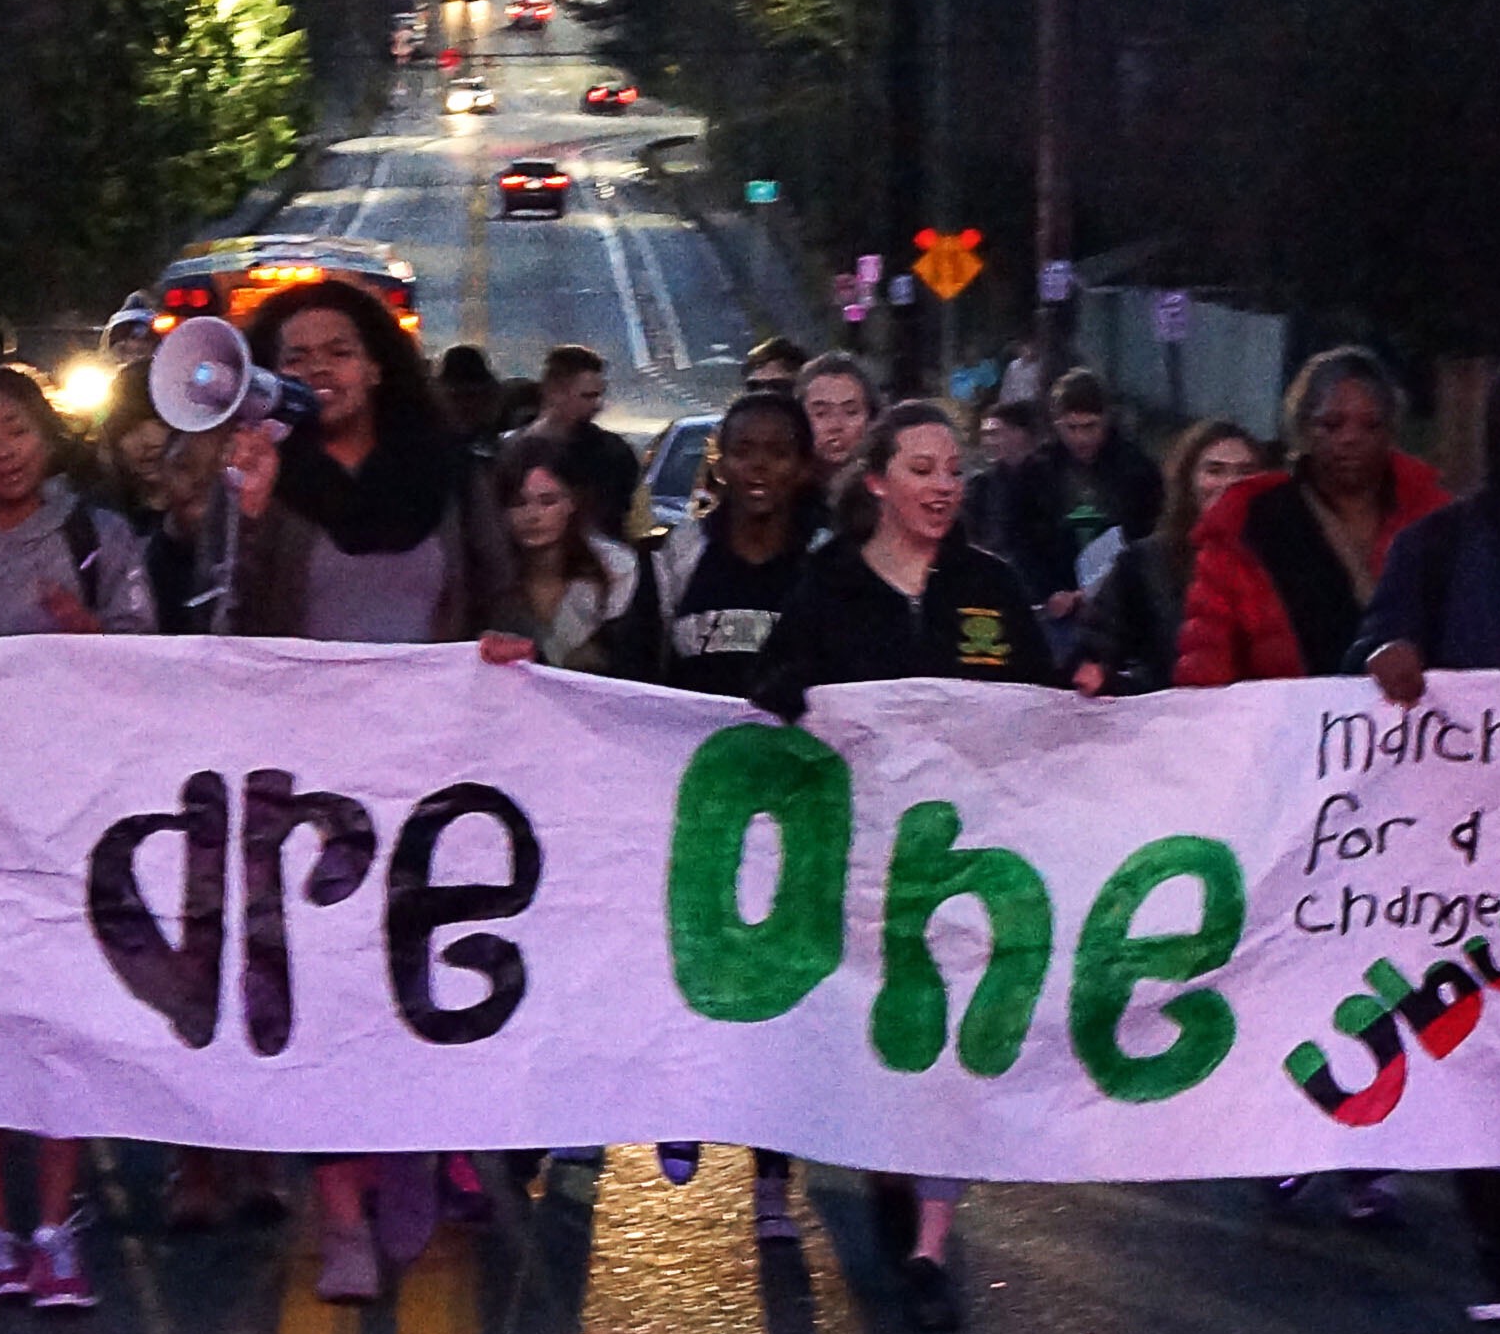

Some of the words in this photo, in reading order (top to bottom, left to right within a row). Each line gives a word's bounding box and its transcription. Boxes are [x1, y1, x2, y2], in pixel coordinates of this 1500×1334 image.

[86, 769, 545, 1056] are
[666, 723, 1247, 1103] One
[1304, 793, 1417, 875] for
[1451, 809, 1482, 865] a
